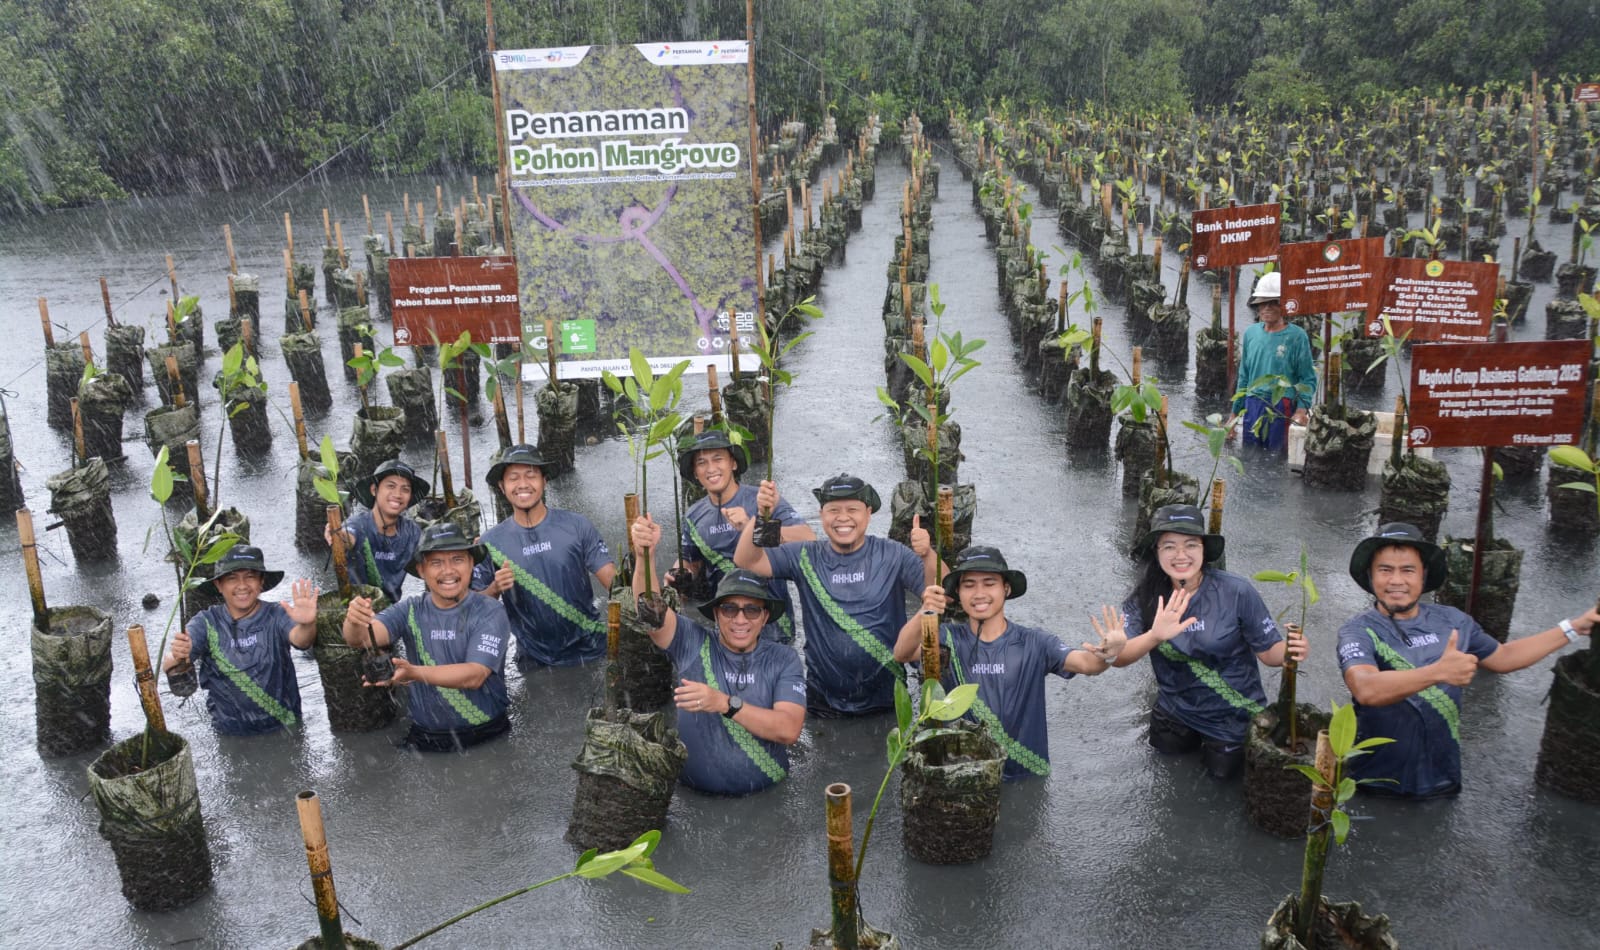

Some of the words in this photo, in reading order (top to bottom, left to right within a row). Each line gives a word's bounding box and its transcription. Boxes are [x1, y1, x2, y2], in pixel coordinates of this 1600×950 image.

[510, 111, 685, 136] Penanaman
[514, 147, 595, 171] Pohon
[605, 142, 737, 170] Mangrove
[1196, 221, 1222, 233] Bank
[1225, 215, 1275, 230] Indonesia
[1220, 231, 1252, 244] DKMP
[409, 286, 447, 295] Program
[449, 284, 501, 293] Penanaman
[395, 298, 422, 307] Pohon
[424, 297, 452, 306] Bakau
[454, 296, 479, 305] Bulan
[480, 295, 493, 303] K3
[495, 294, 518, 303] 2025
[1426, 294, 1467, 302] Oktavia
[1421, 301, 1467, 310] Muzahidi
[1382, 307, 1413, 315] Zahra
[1415, 308, 1451, 316] Amalia
[1453, 310, 1478, 318] Putri
[1440, 317, 1482, 326] Rabbani
[1454, 367, 1478, 388] Group
[1480, 366, 1517, 383] Business
[1518, 365, 1558, 386] Gathering
[1559, 364, 1582, 382] 2025
[1439, 409, 1451, 418] PT
[1512, 434, 1522, 443] 15
[1523, 433, 1553, 443] Februari
[1553, 433, 1573, 443] 2025
[709, 523, 733, 535] AKHLA
[832, 572, 865, 584] AKHLAK
[480, 634, 502, 644] SEHAT
[477, 645, 500, 657] SEGAR
